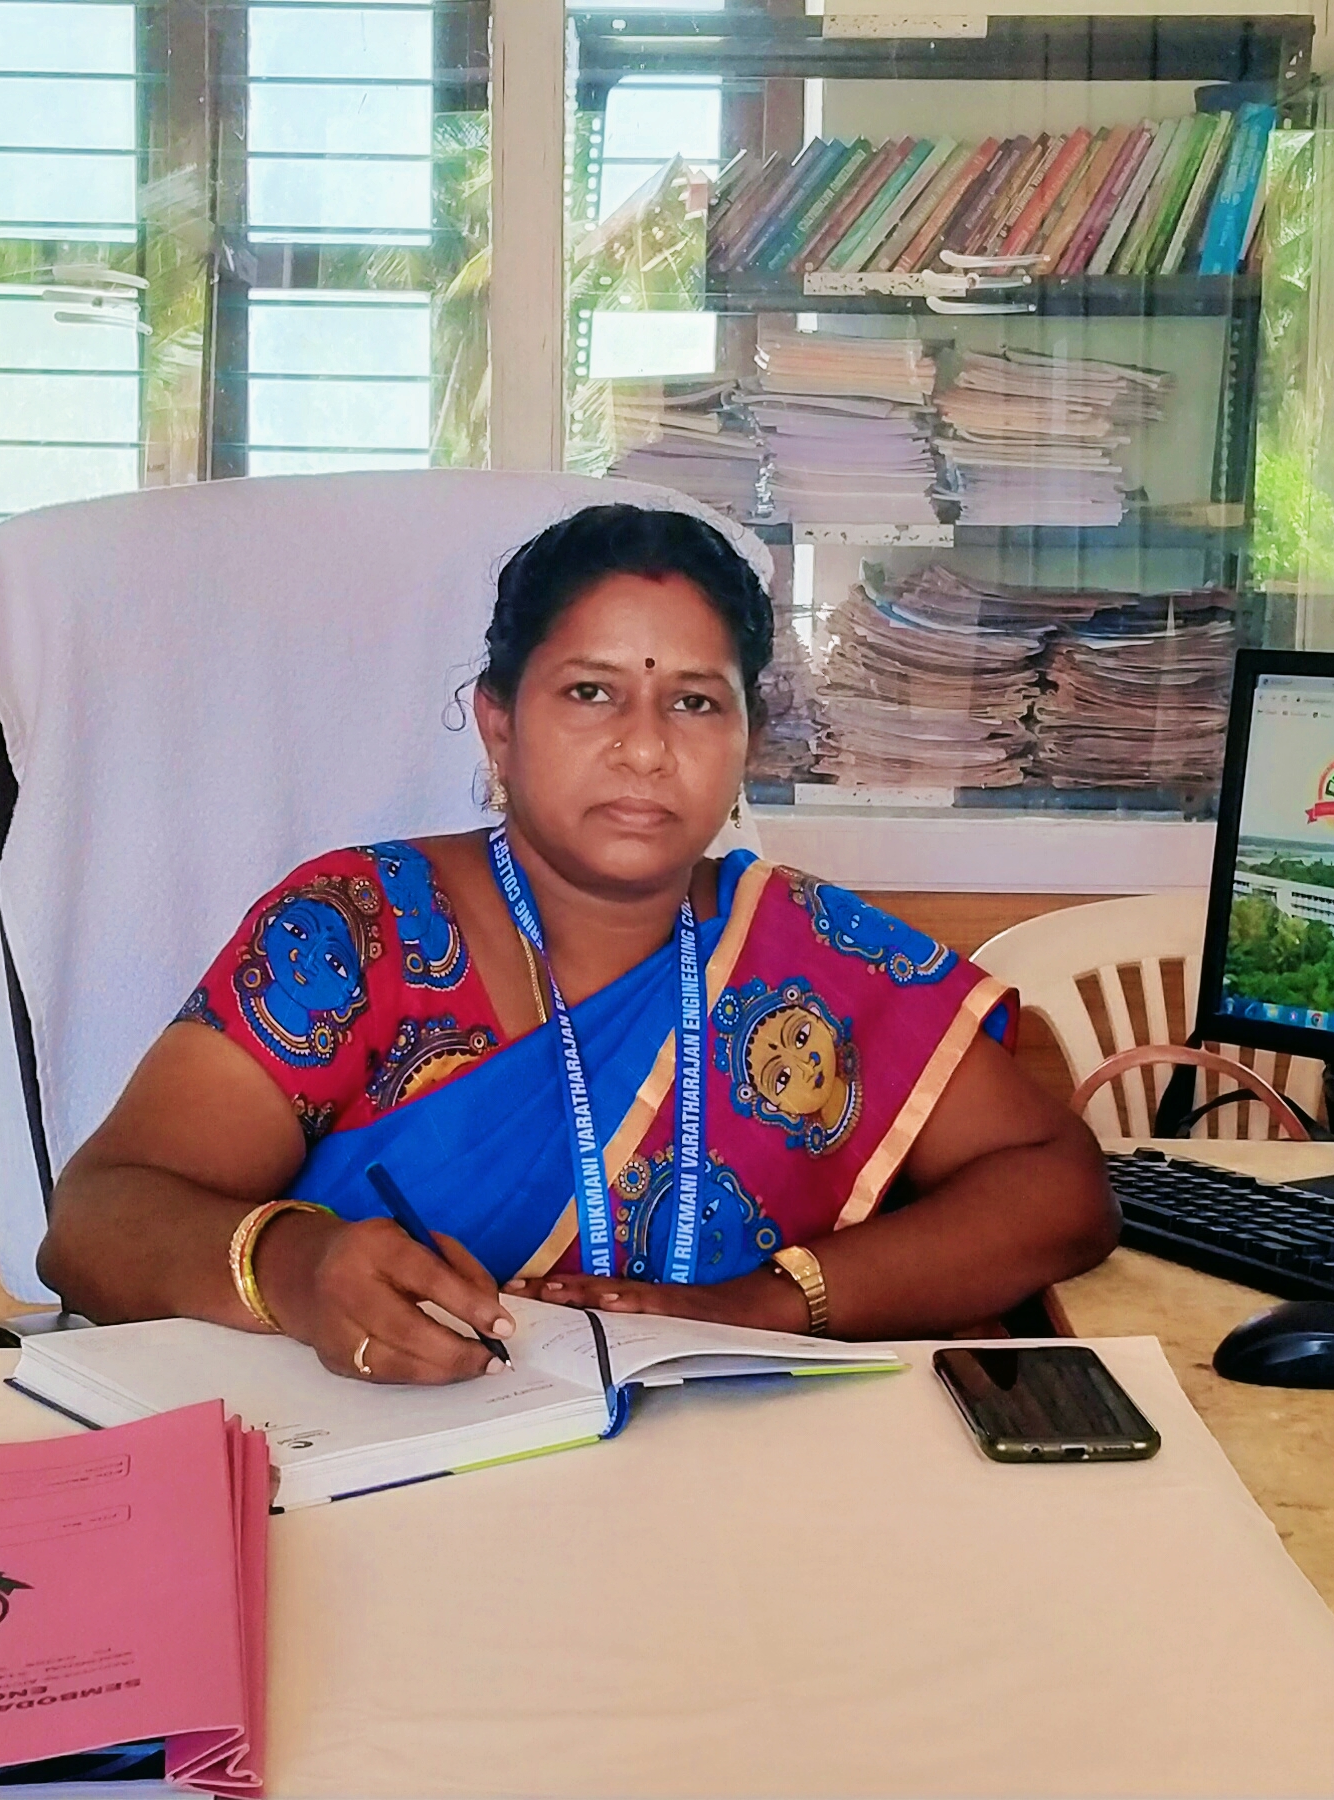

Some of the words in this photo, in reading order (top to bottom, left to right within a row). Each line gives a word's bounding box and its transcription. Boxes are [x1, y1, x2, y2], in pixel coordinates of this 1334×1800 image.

[493, 836, 521, 902] COLLEGE
[680, 929, 701, 1030] ENGINEERING
[555, 1015, 598, 1153] VARATHARAJAN
[681, 1034, 701, 1168] VARATHARAJAN
[583, 1157, 609, 1244] RUKMANI
[673, 1172, 699, 1260] RUKMANI
